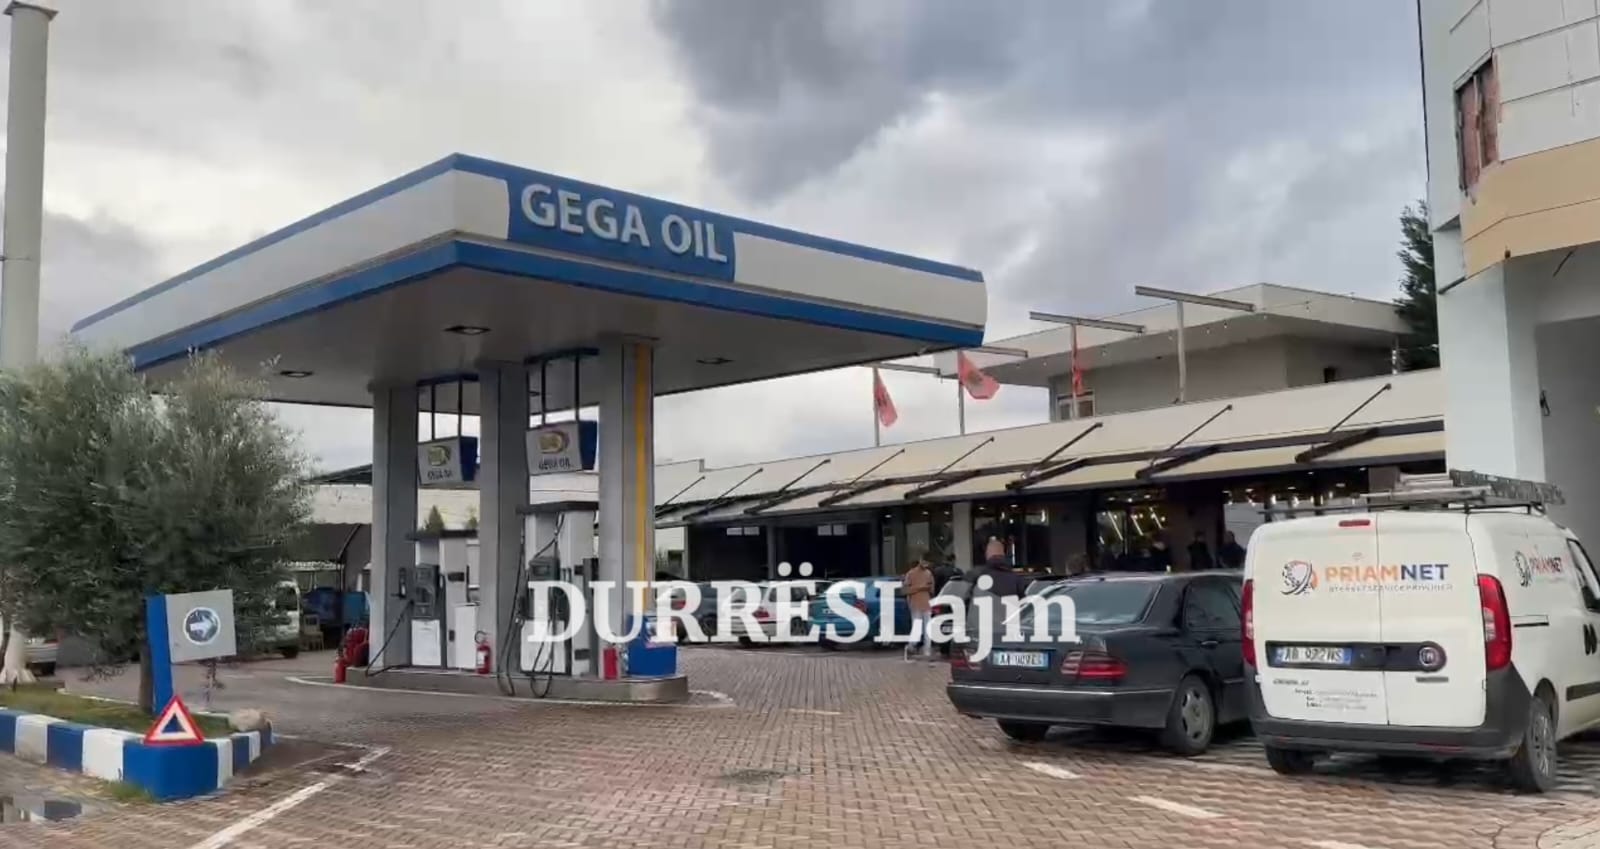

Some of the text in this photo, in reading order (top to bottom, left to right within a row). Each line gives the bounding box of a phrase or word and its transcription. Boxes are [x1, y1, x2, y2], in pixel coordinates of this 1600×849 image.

[521, 183, 728, 263] GEGA OIL
[1325, 563, 1449, 582] PRIAMNET
